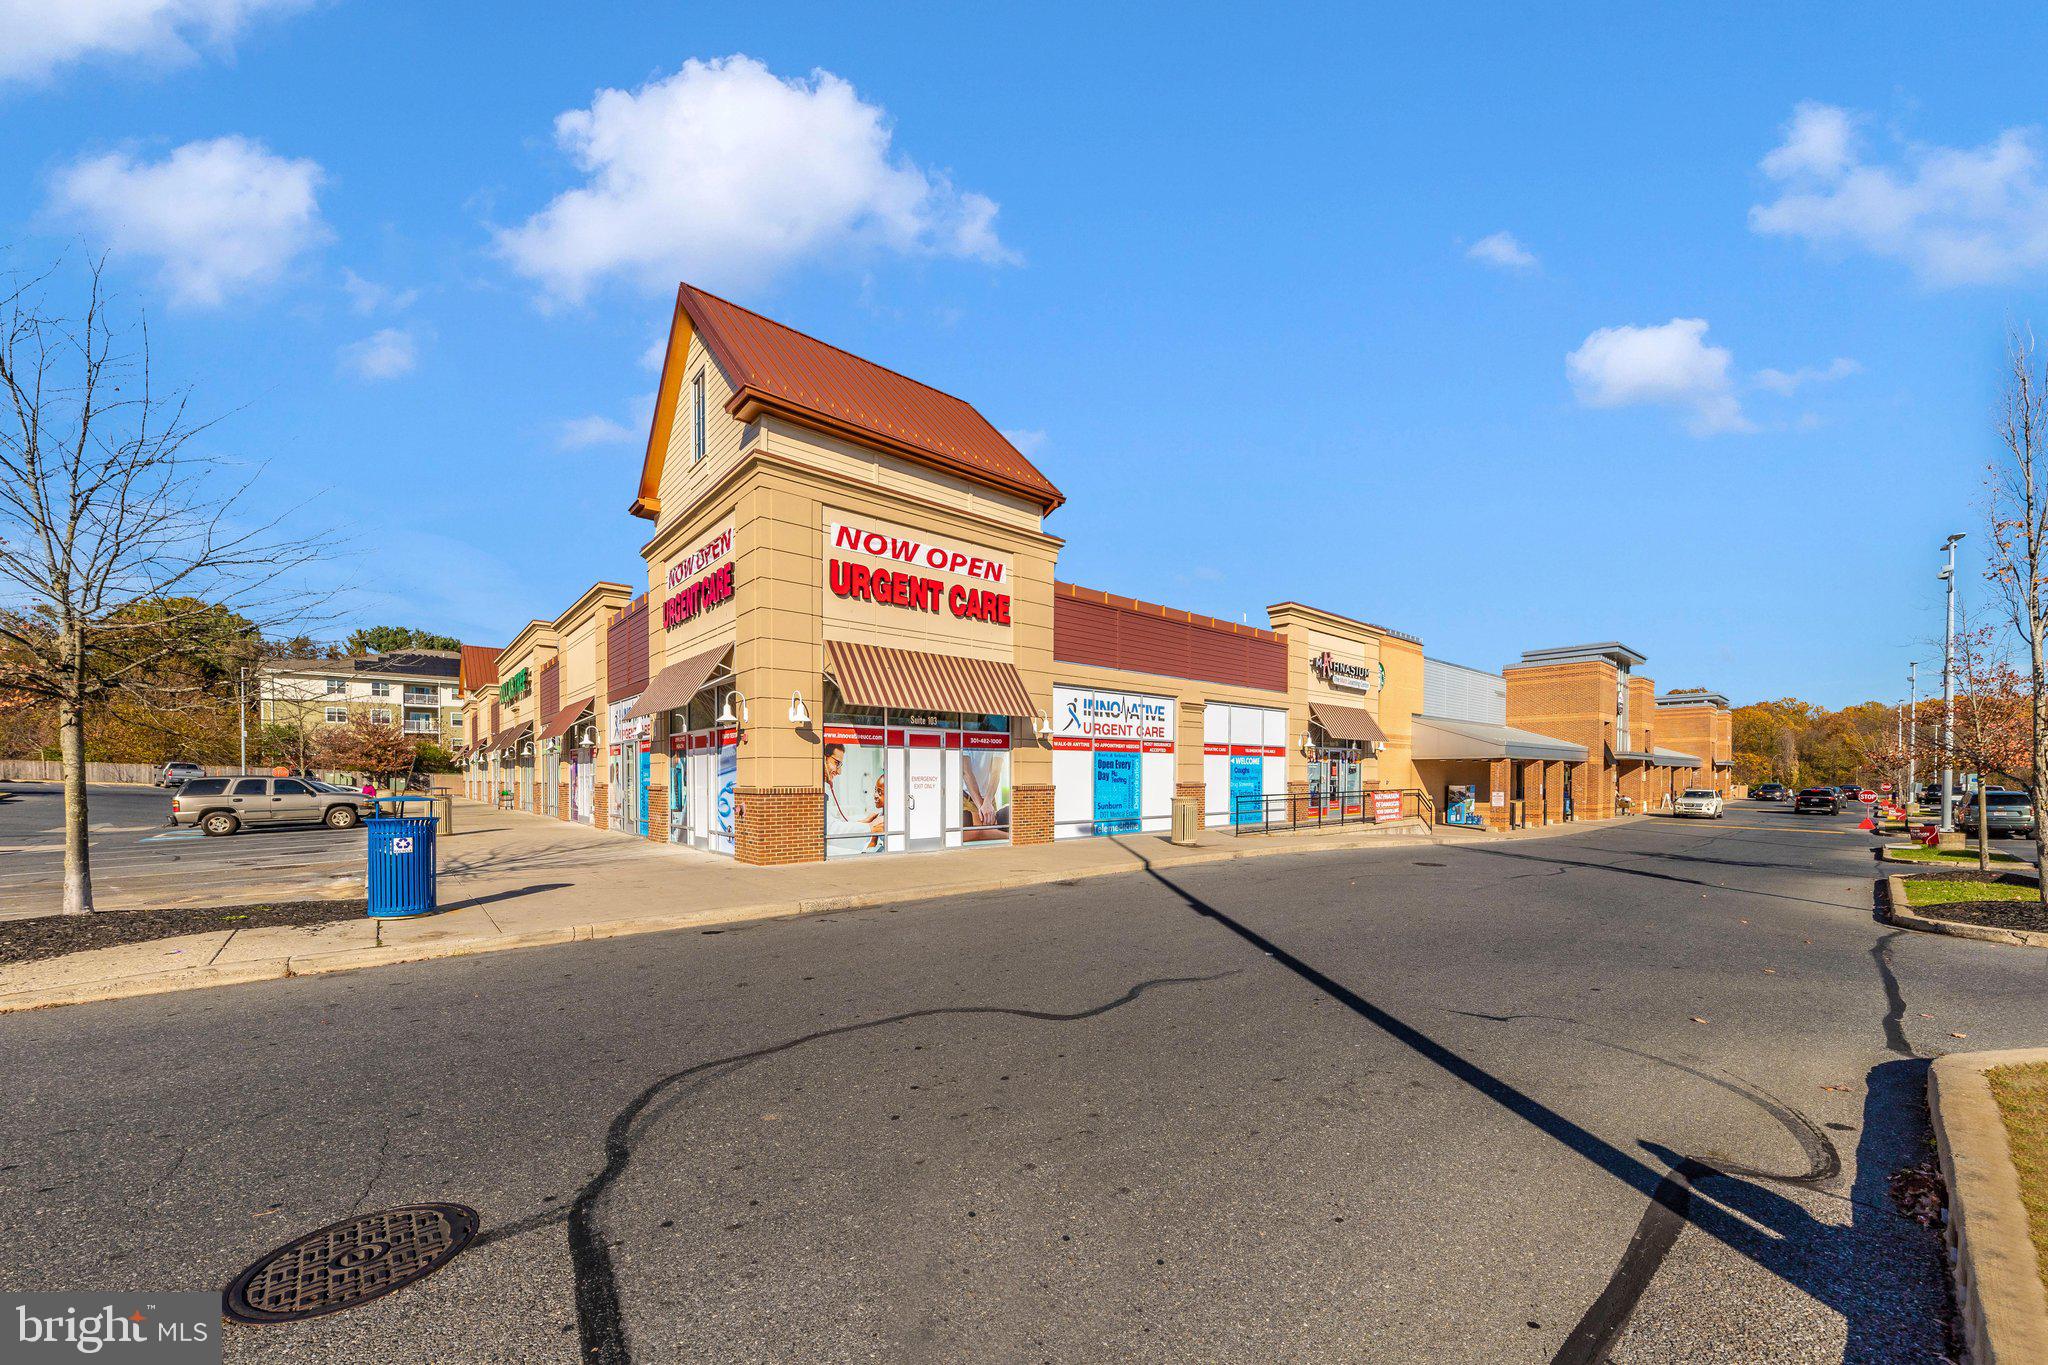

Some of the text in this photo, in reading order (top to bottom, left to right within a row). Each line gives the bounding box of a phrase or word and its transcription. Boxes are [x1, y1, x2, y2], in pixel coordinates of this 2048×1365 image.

[668, 527, 733, 590] NOW OPEN
[835, 525, 1004, 582] NOW OPEN
[662, 561, 735, 630] URGENT CARE
[830, 558, 1011, 625] URGENT CARE
[1315, 651, 1370, 678] MATHNASIUM
[910, 715, 938, 726] Suite 103
[1083, 722, 1165, 738] URGENT CARE
[1097, 758, 1131, 771] Open Every
[911, 775, 938, 783] EMERGENCY
[1097, 770, 1110, 781] Day
[1097, 801, 1123, 810] Sunburn
[1094, 822, 1139, 834] Telemedicine
